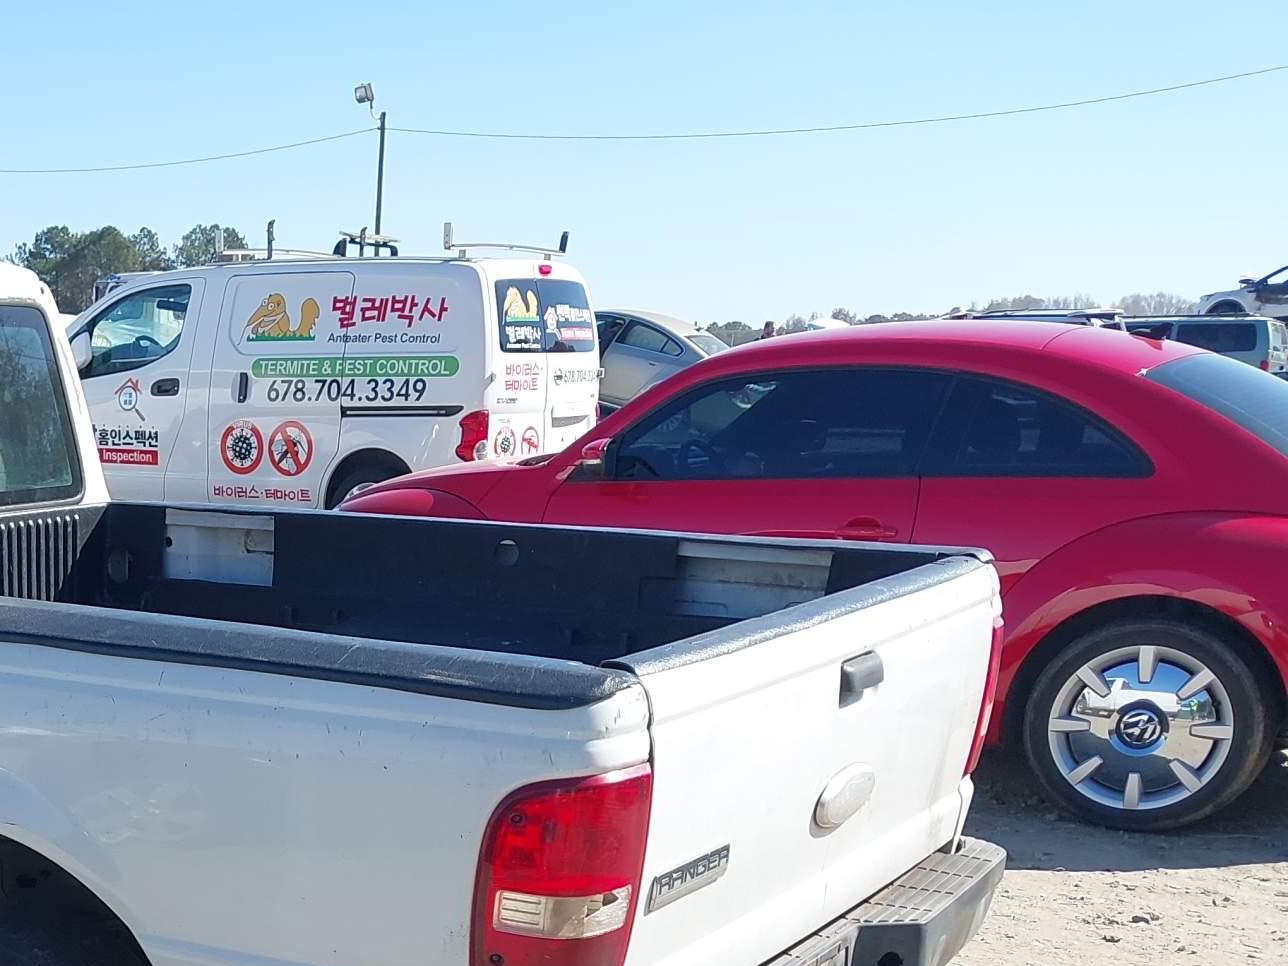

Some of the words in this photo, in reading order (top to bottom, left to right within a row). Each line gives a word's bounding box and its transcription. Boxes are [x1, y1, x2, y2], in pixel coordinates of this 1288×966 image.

[331, 294, 449, 330] 벌레박사
[327, 332, 372, 344] Anteater
[374, 332, 398, 344] Pest
[400, 332, 441, 344] Control
[260, 360, 319, 375] TERMITE
[322, 360, 332, 375] &
[336, 360, 373, 375] PEST
[376, 359, 450, 374] CONTROL
[267, 378, 427, 402] 678.704.3349
[102, 449, 153, 463] Inspection
[657, 843, 730, 896] RANGER
